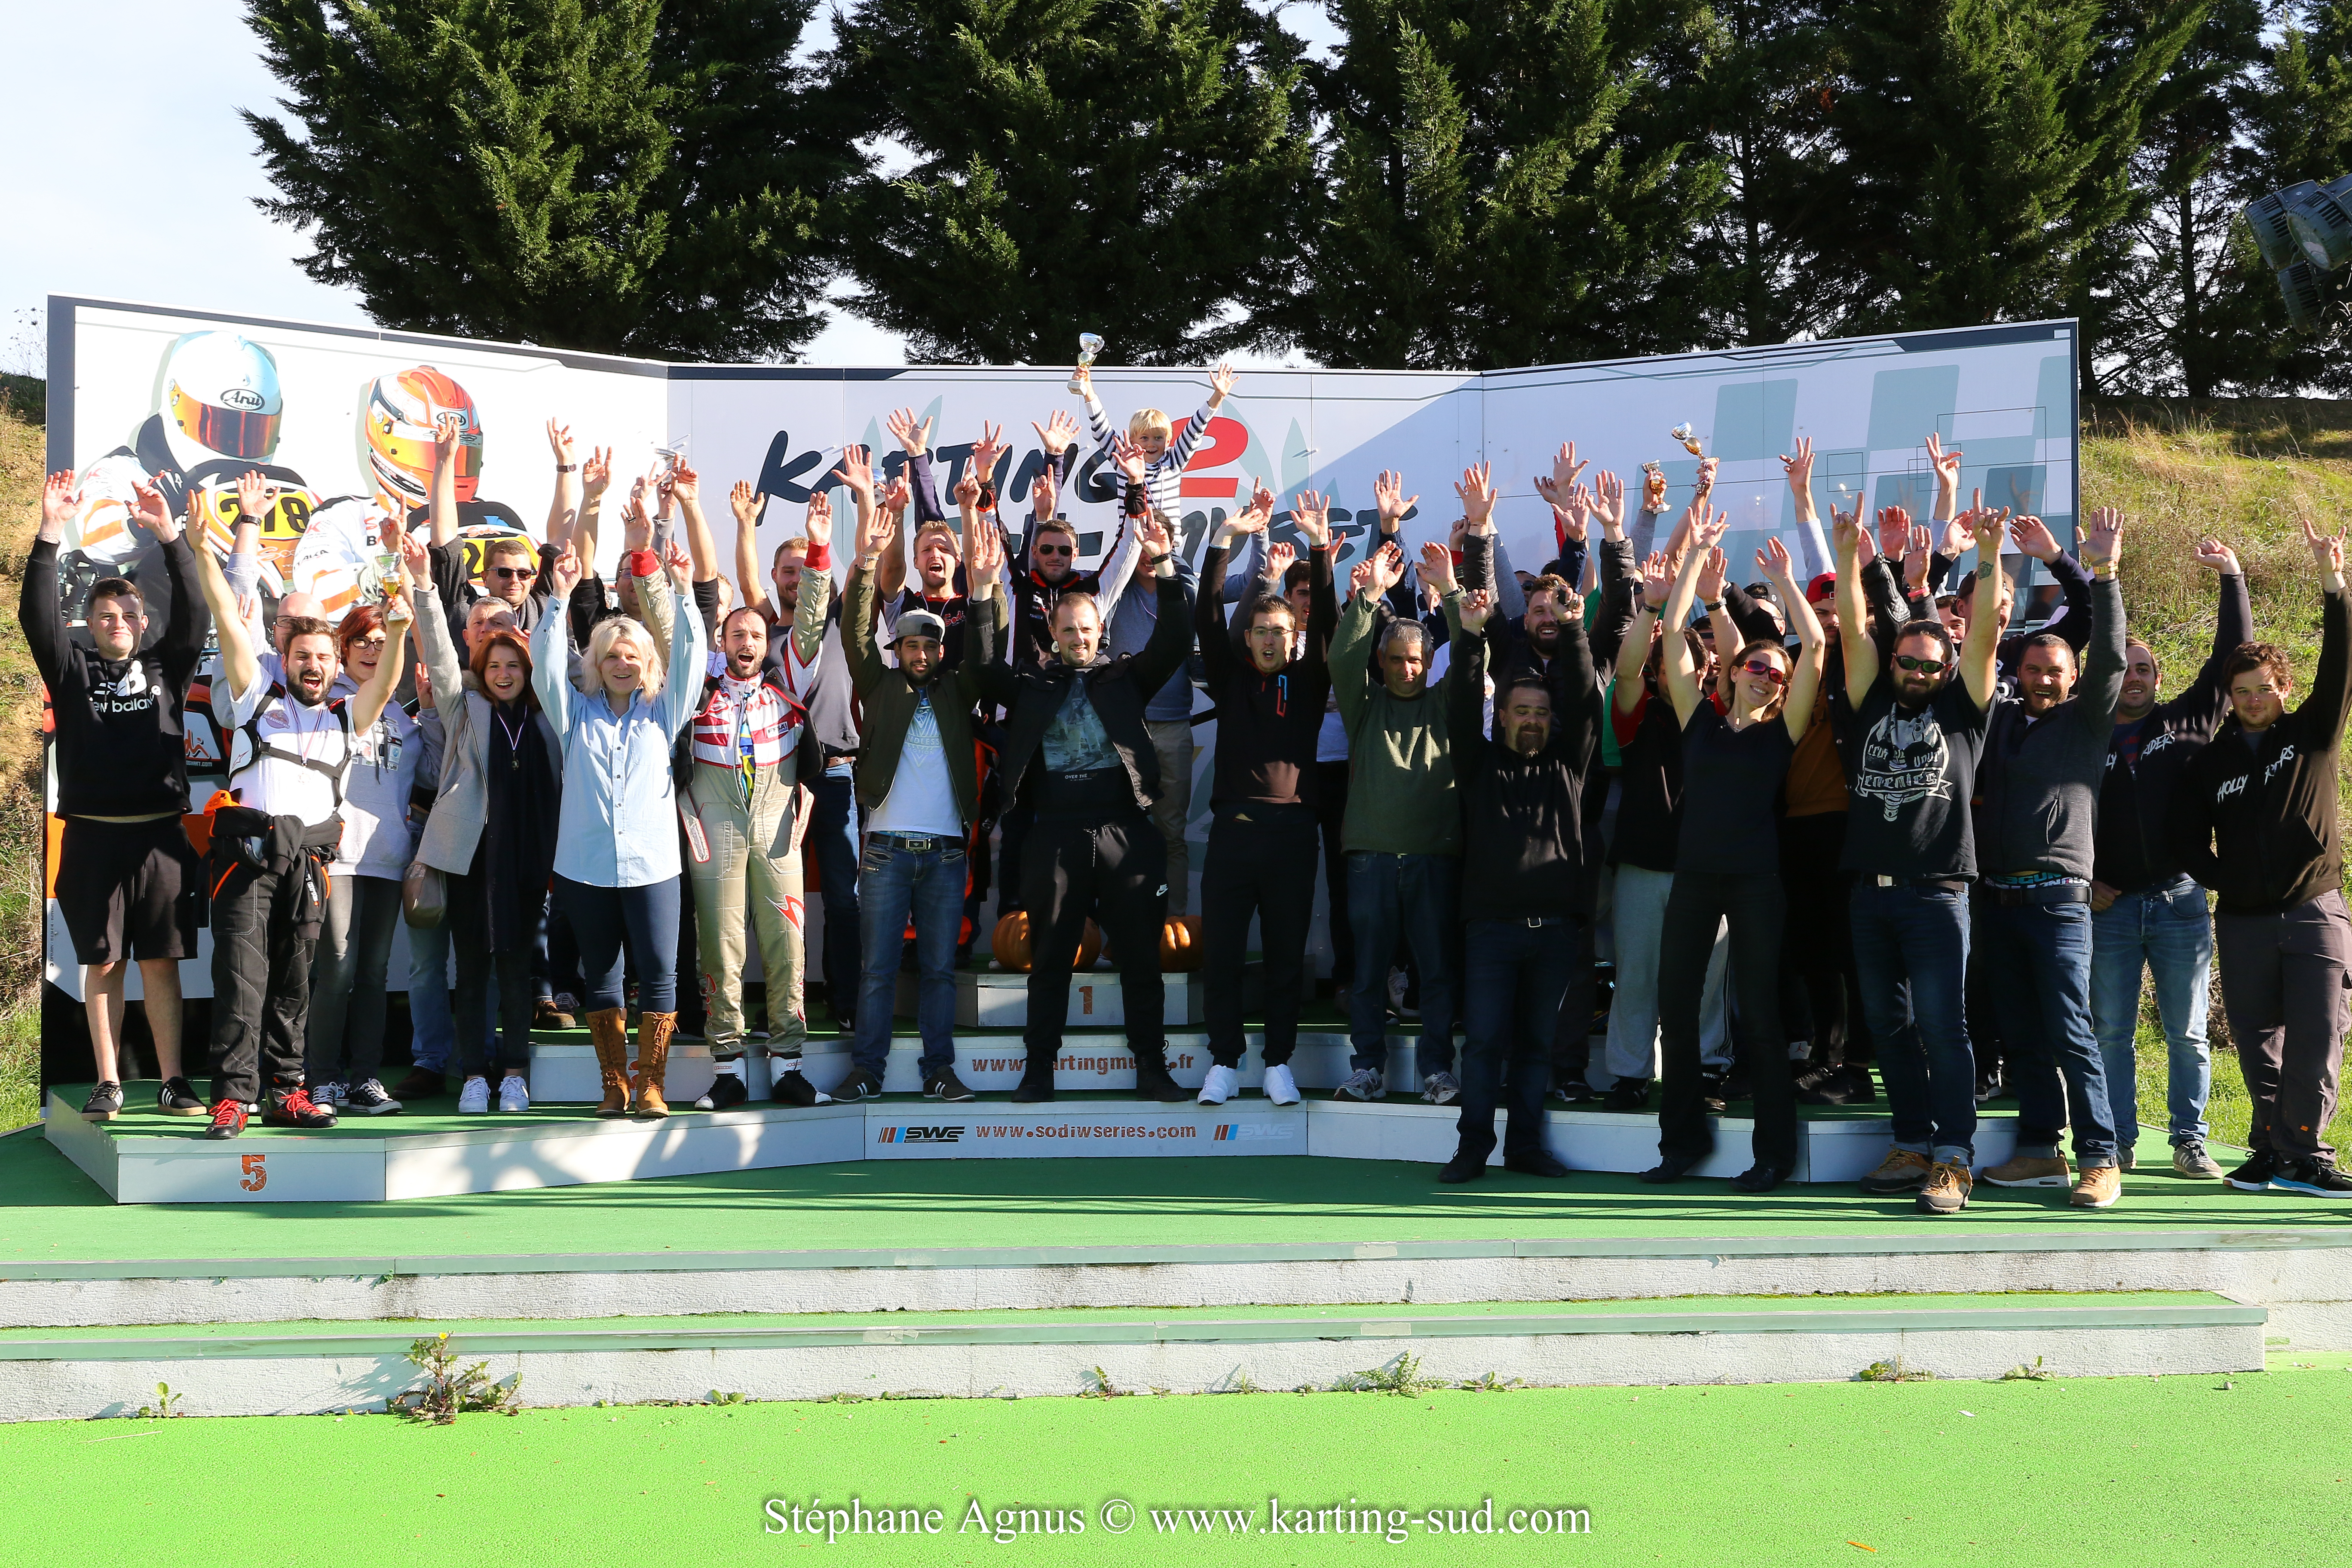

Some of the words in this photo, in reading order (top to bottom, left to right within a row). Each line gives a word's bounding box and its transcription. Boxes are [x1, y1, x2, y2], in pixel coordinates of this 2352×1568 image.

[224, 391, 261, 406] Arai
[1170, 416, 1248, 498] 2
[466, 527, 502, 538] Sodi
[89, 696, 108, 713] ew
[906, 735, 940, 745] NDLESS
[2217, 774, 2248, 804] HOLLY
[1078, 985, 1093, 1015] 1
[975, 1124, 1197, 1139] www.sodiwseries.com
[239, 1154, 268, 1192] 5
